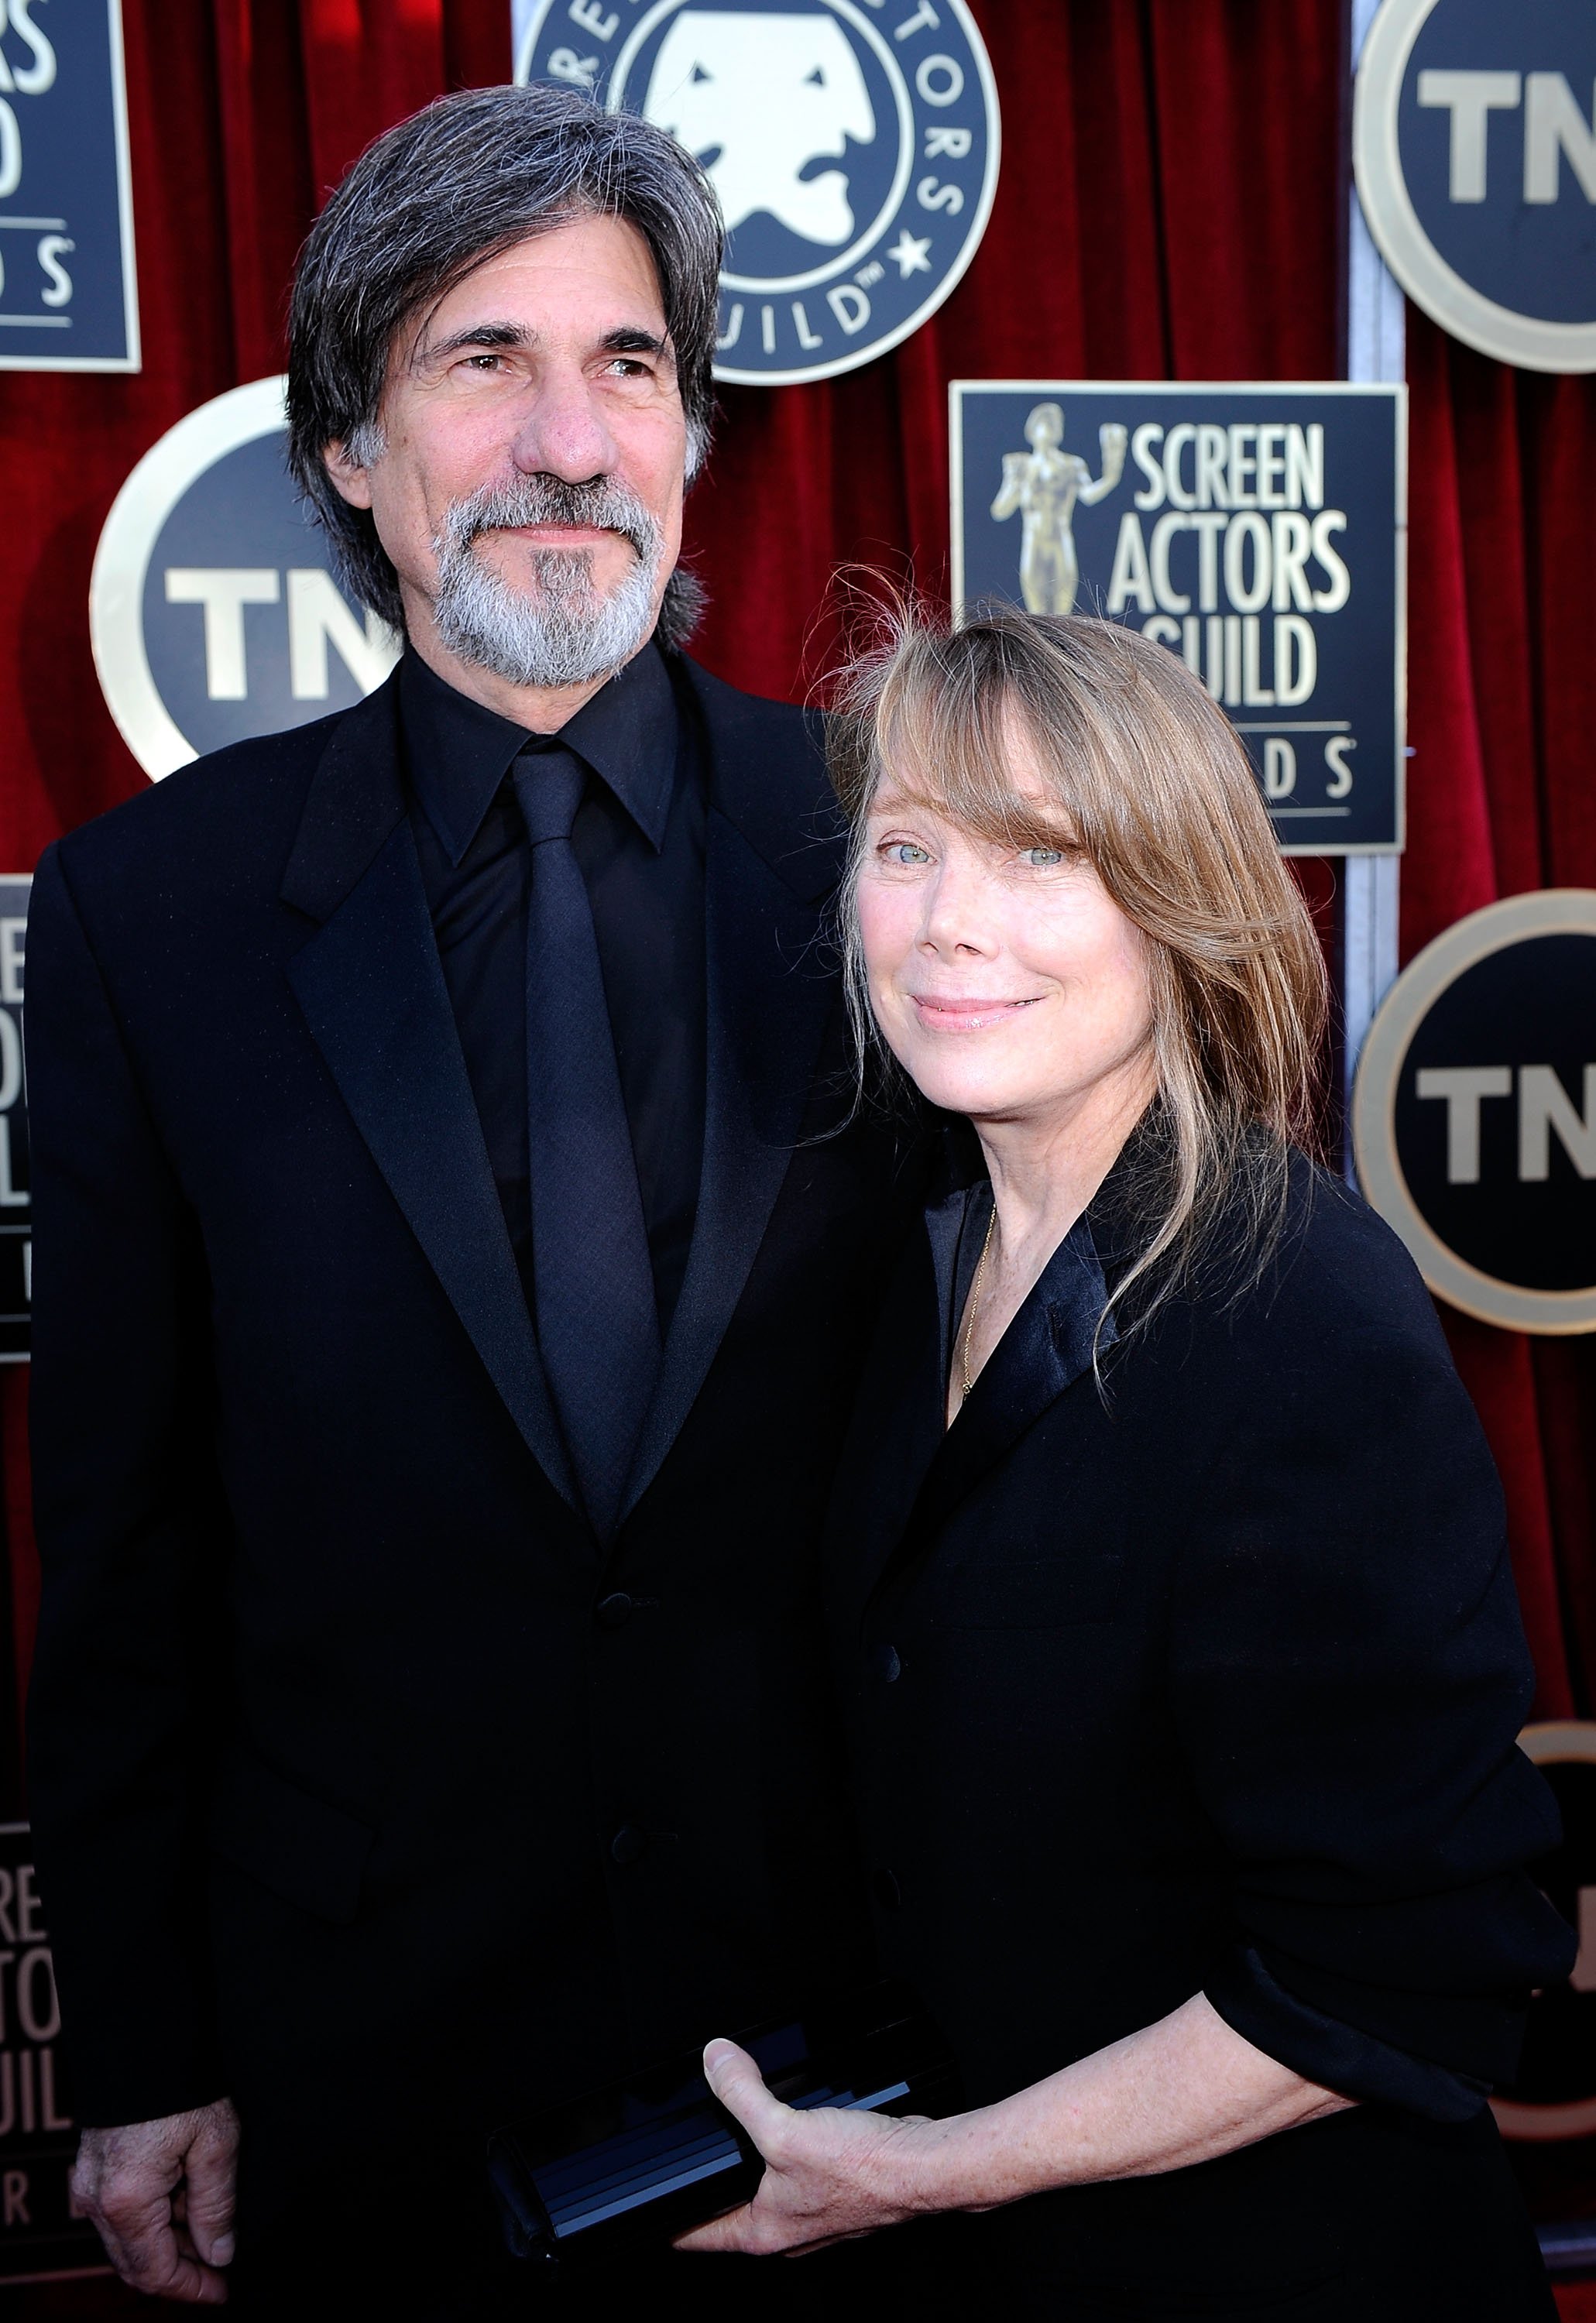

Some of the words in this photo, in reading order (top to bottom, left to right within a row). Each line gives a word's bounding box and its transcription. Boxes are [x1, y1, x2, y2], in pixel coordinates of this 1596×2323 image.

[1131, 423, 1324, 511] SCREEN
[1107, 510, 1351, 614] ACTORS
[164, 568, 404, 701] TN
[1416, 1065, 1596, 1185] TN
